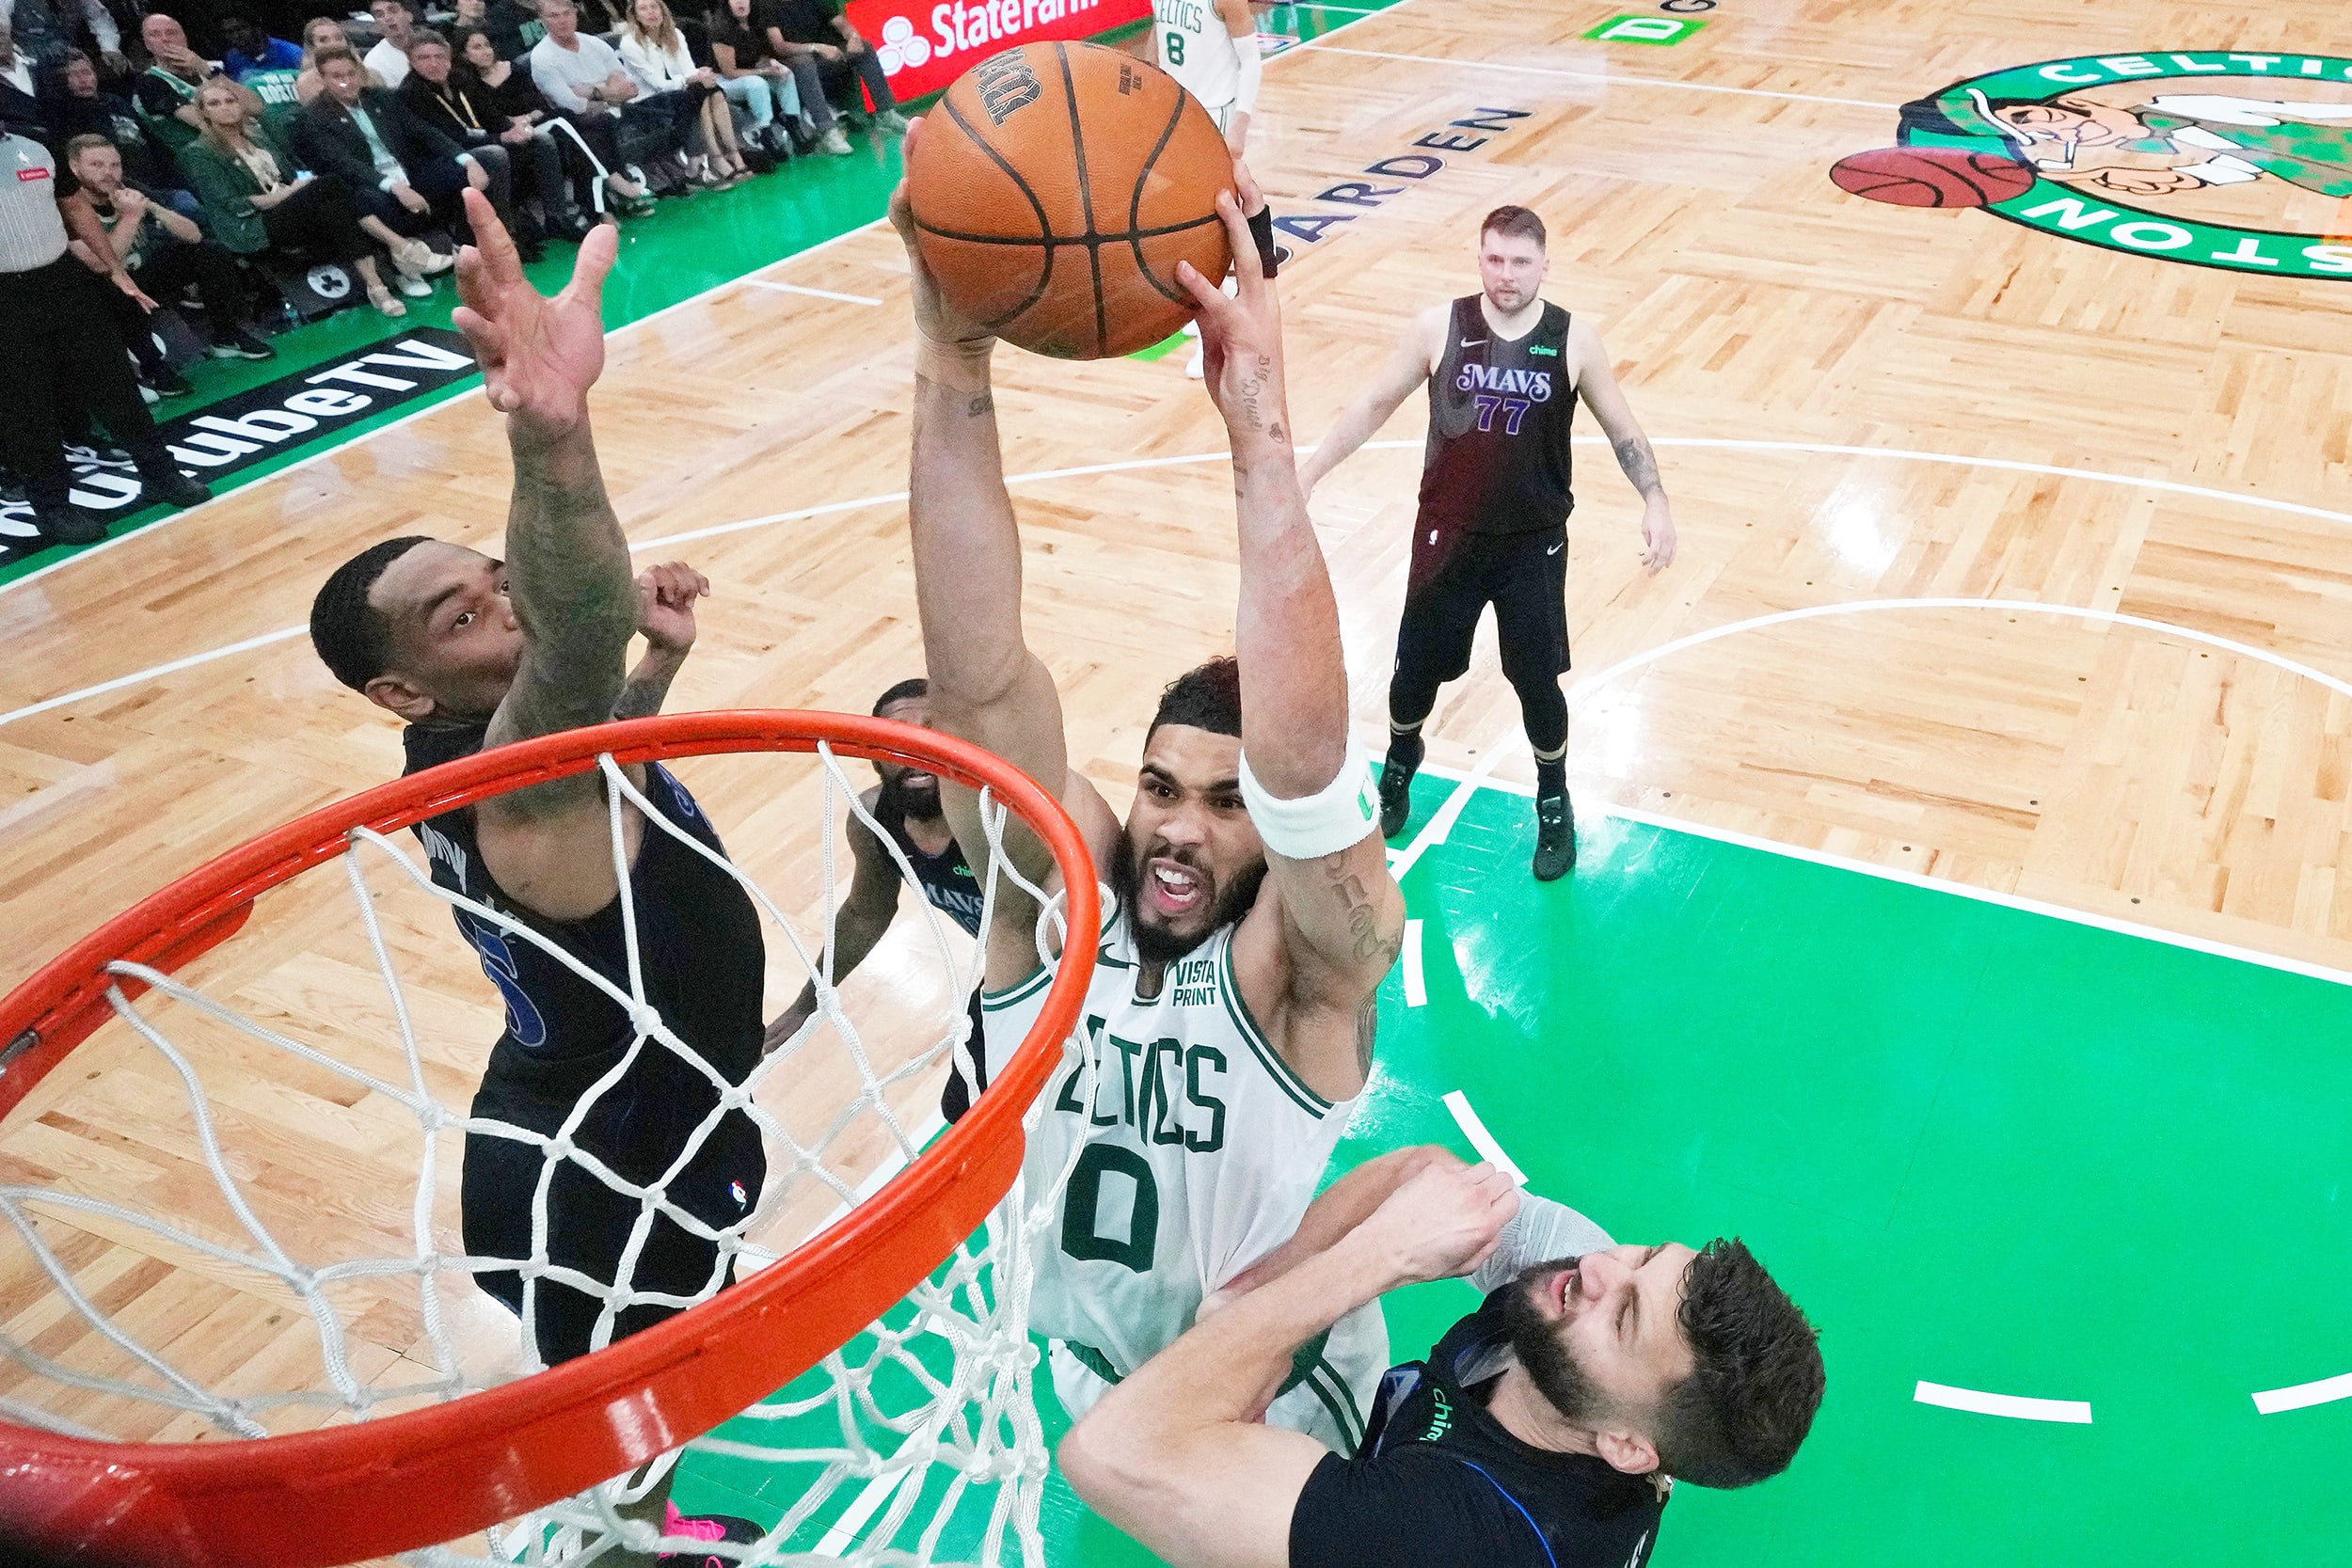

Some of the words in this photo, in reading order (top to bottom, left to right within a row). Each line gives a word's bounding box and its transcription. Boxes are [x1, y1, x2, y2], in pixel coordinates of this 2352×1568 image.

[1166, 32, 1184, 67] 8
[2038, 54, 2352, 83] CELTI
[1529, 344, 1558, 356] chime
[1456, 363, 1552, 403] MAVS
[1474, 395, 1531, 436] 77
[1176, 959, 1216, 986] VISTA
[1172, 987, 1216, 1006] PRINT
[1061, 1143, 1159, 1274] 0
